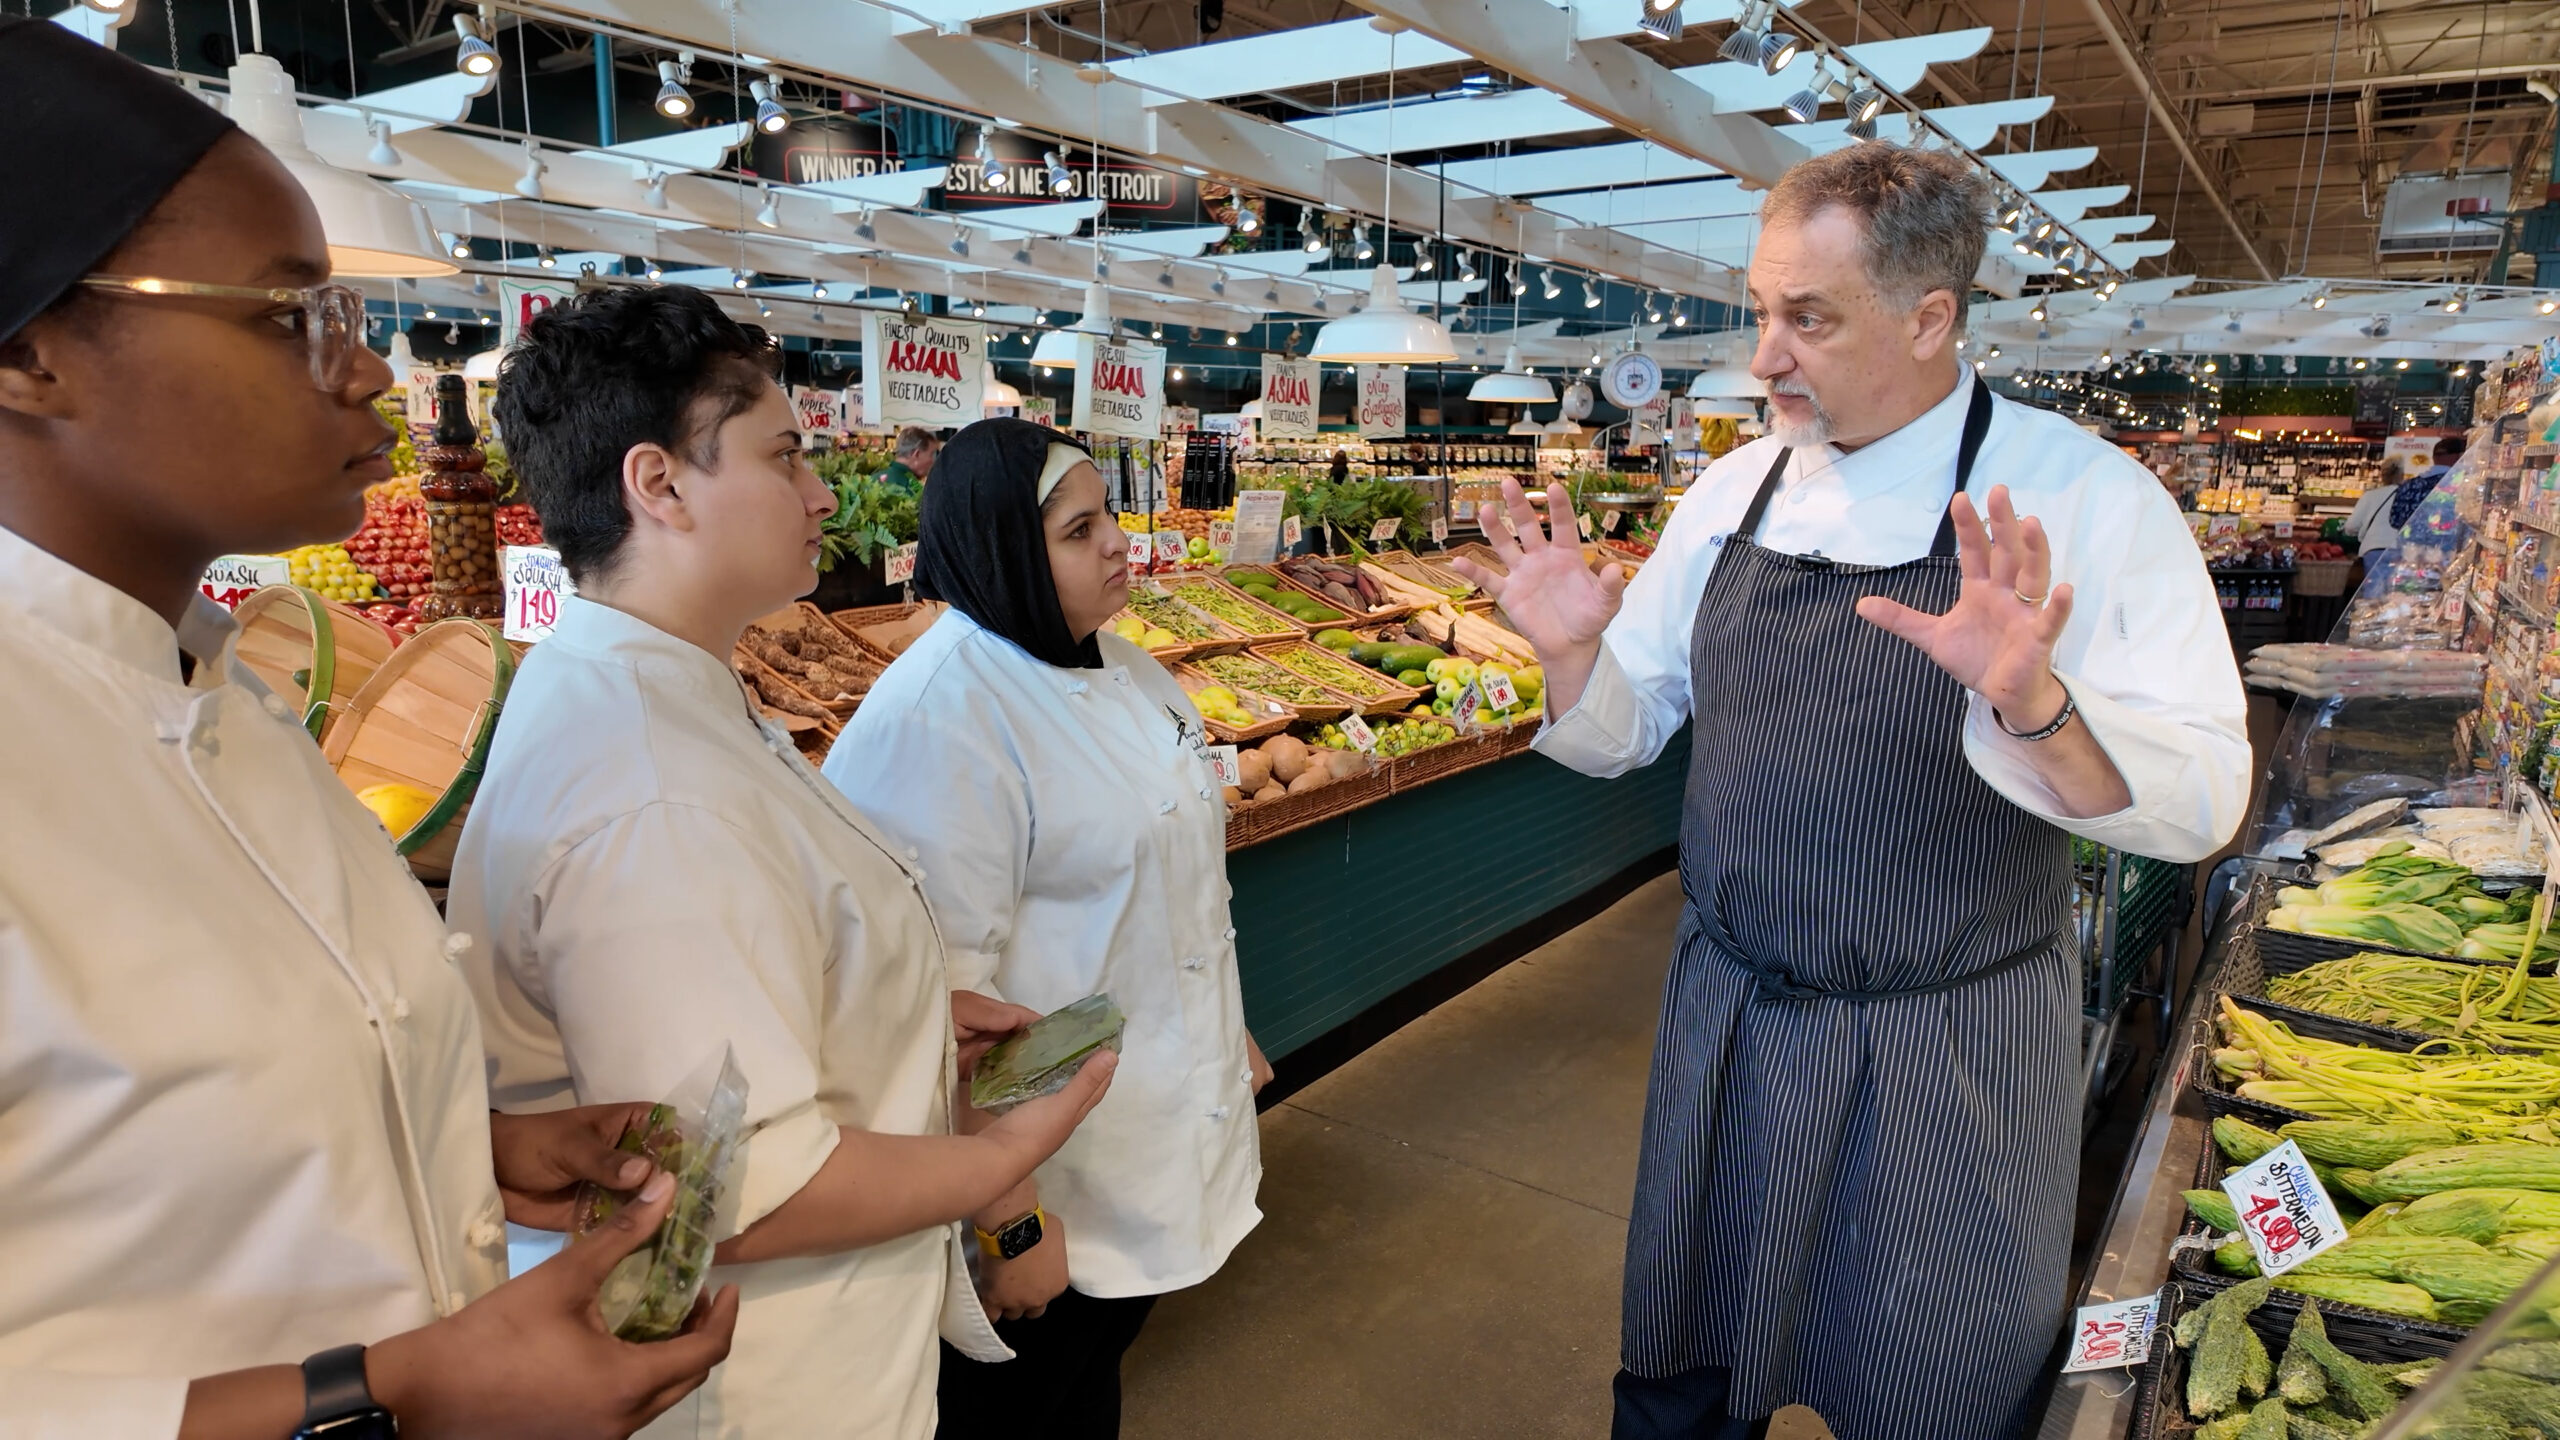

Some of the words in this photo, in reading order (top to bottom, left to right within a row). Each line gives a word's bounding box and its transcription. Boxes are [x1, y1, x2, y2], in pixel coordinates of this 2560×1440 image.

[1087, 172, 1164, 202] DETROIT
[924, 326, 970, 355] QUALITY
[886, 340, 963, 382] ASIAN
[1092, 357, 1146, 399] ASIAN
[1266, 373, 1312, 407] ASIAN
[798, 397, 837, 418] APPLES
[888, 380, 961, 411] VEGETABLES
[1093, 397, 1143, 421] EGETABLES
[1269, 408, 1311, 428] VEGETABLES
[203, 564, 262, 587] QUASH
[513, 562, 561, 594] SQUASH
[2288, 1165, 2321, 1214] CHINESE
[2268, 1161, 2325, 1251] BITTERMELON
